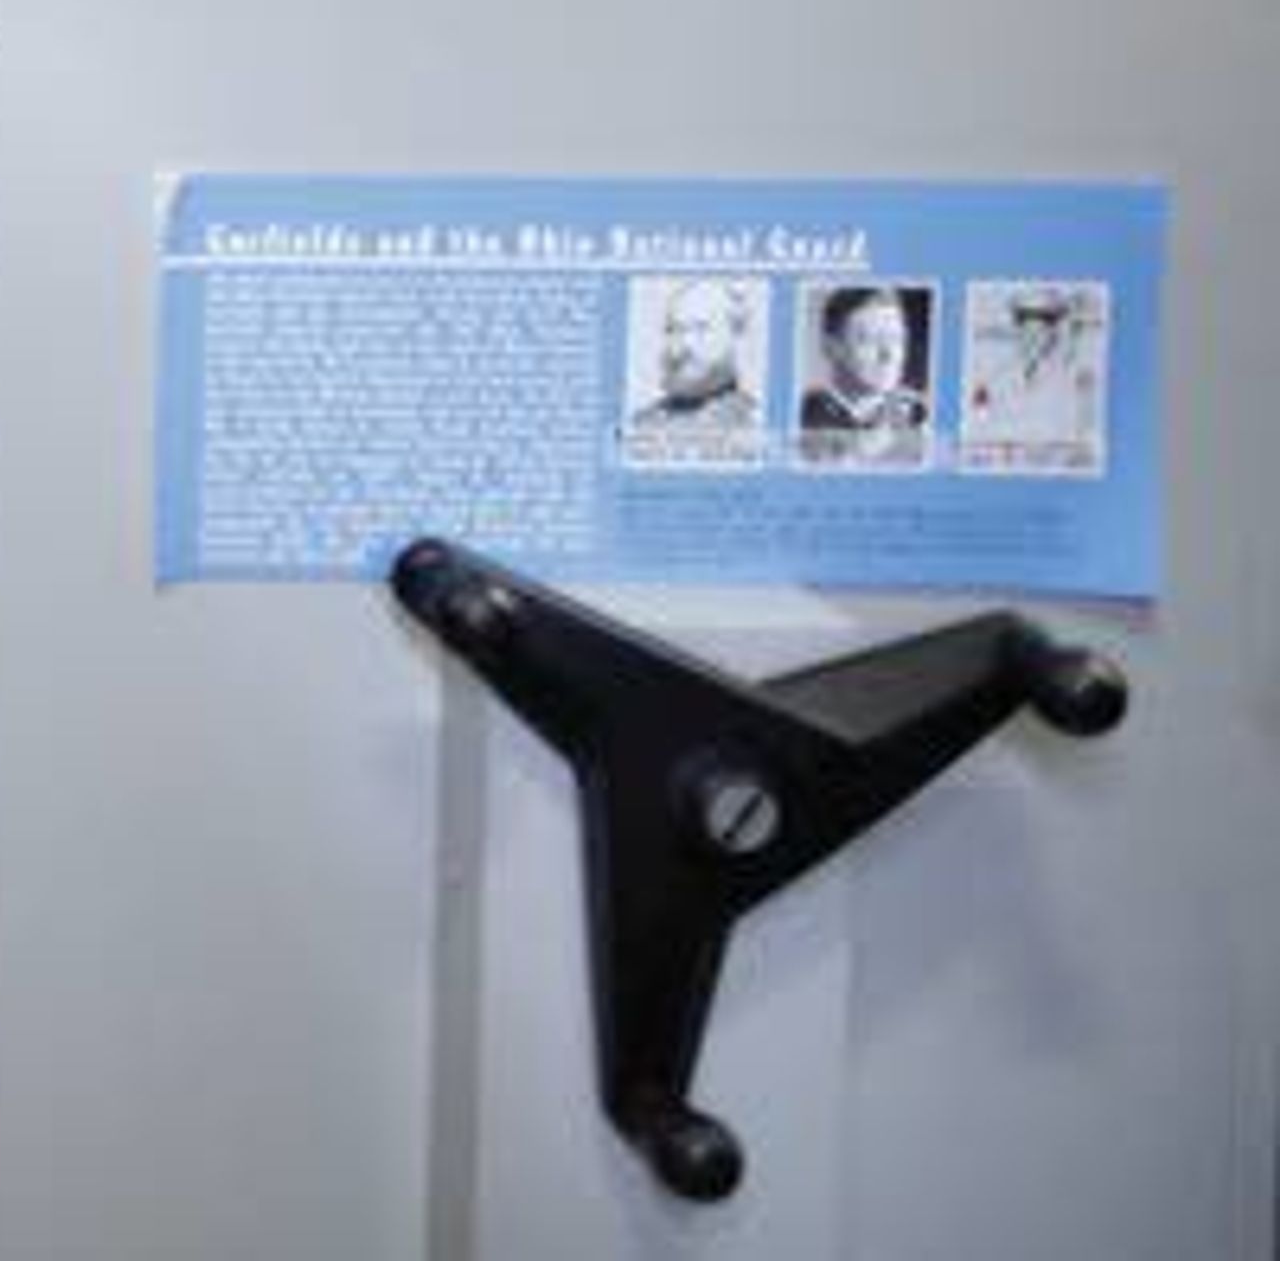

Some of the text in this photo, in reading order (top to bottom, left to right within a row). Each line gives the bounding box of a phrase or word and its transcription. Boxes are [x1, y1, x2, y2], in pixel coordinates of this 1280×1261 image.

[377, 222, 436, 258] and
[447, 223, 502, 258] the
[518, 223, 594, 258] Ohio
[610, 224, 755, 258] National
[767, 224, 868, 259] Guard
